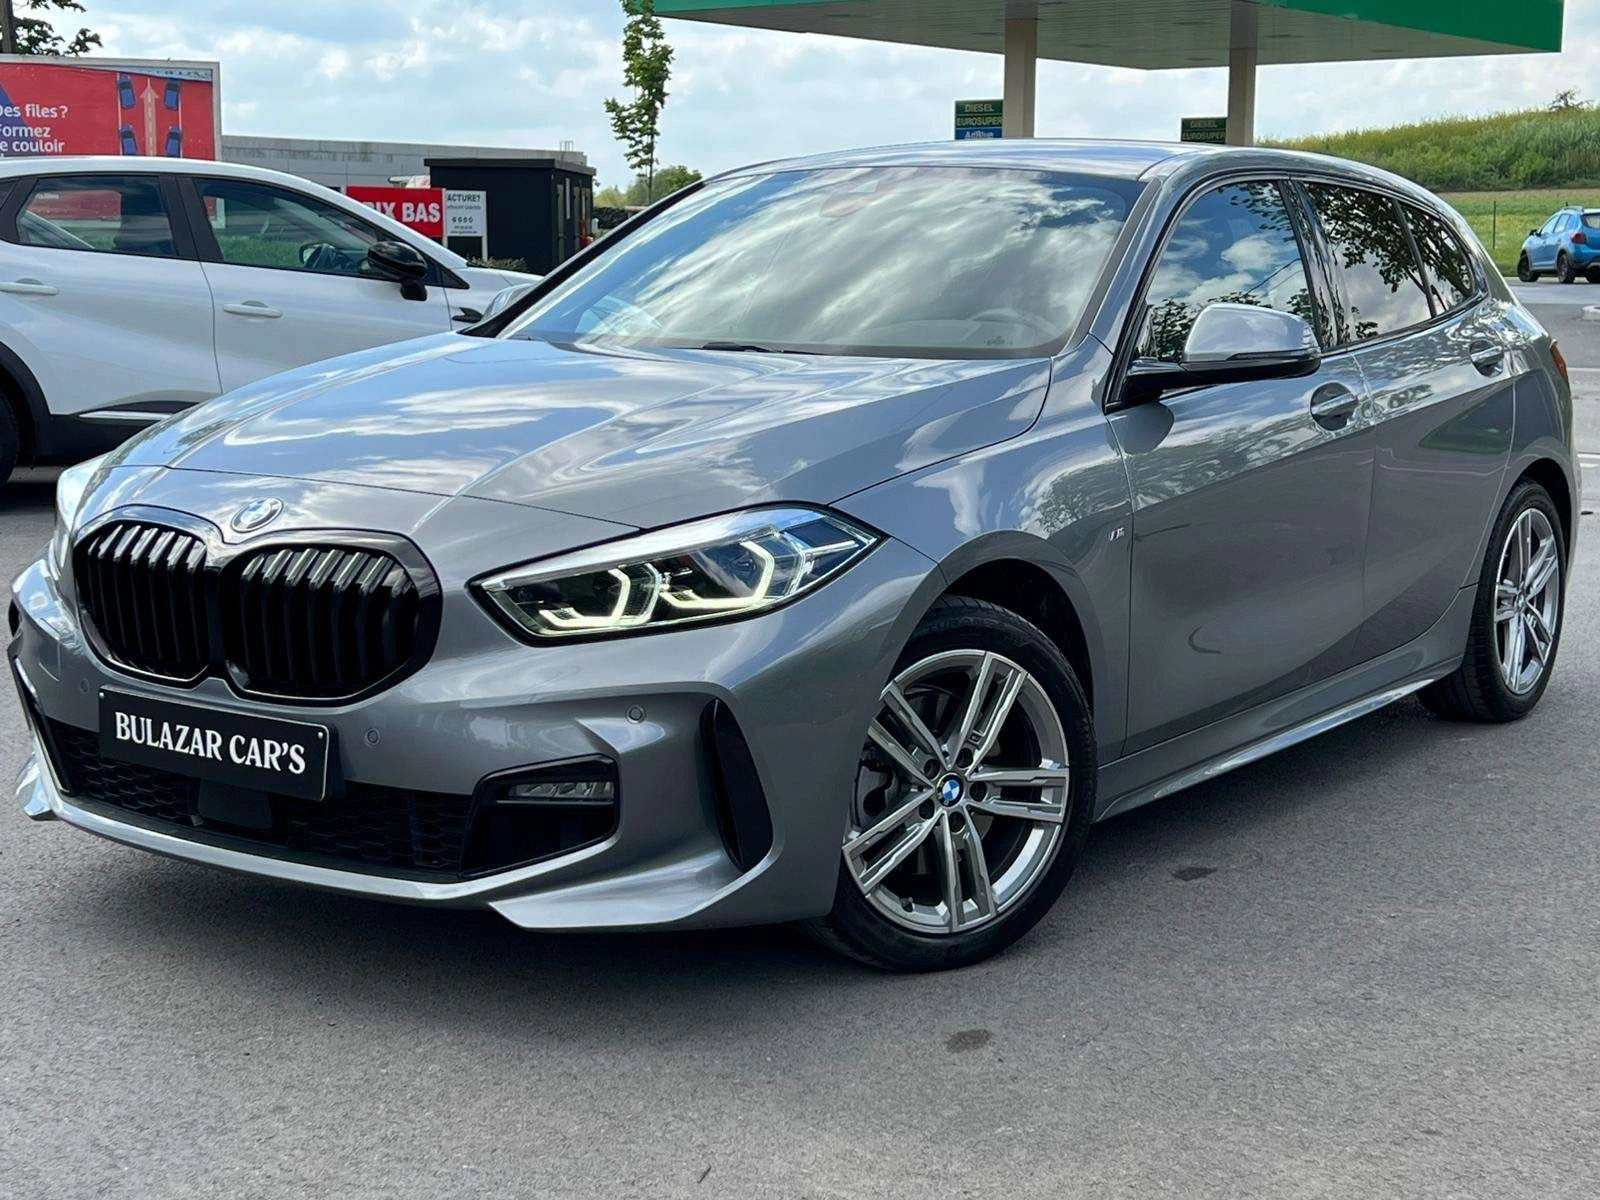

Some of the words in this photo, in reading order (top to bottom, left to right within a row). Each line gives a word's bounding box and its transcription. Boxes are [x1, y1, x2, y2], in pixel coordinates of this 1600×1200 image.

[25, 103, 68, 119] files?
[0, 124, 51, 138] ormez
[12, 138, 66, 153] couloir
[401, 201, 441, 223] BAS
[114, 711, 222, 761] BULAZAR
[229, 734, 306, 775] CAR'S
